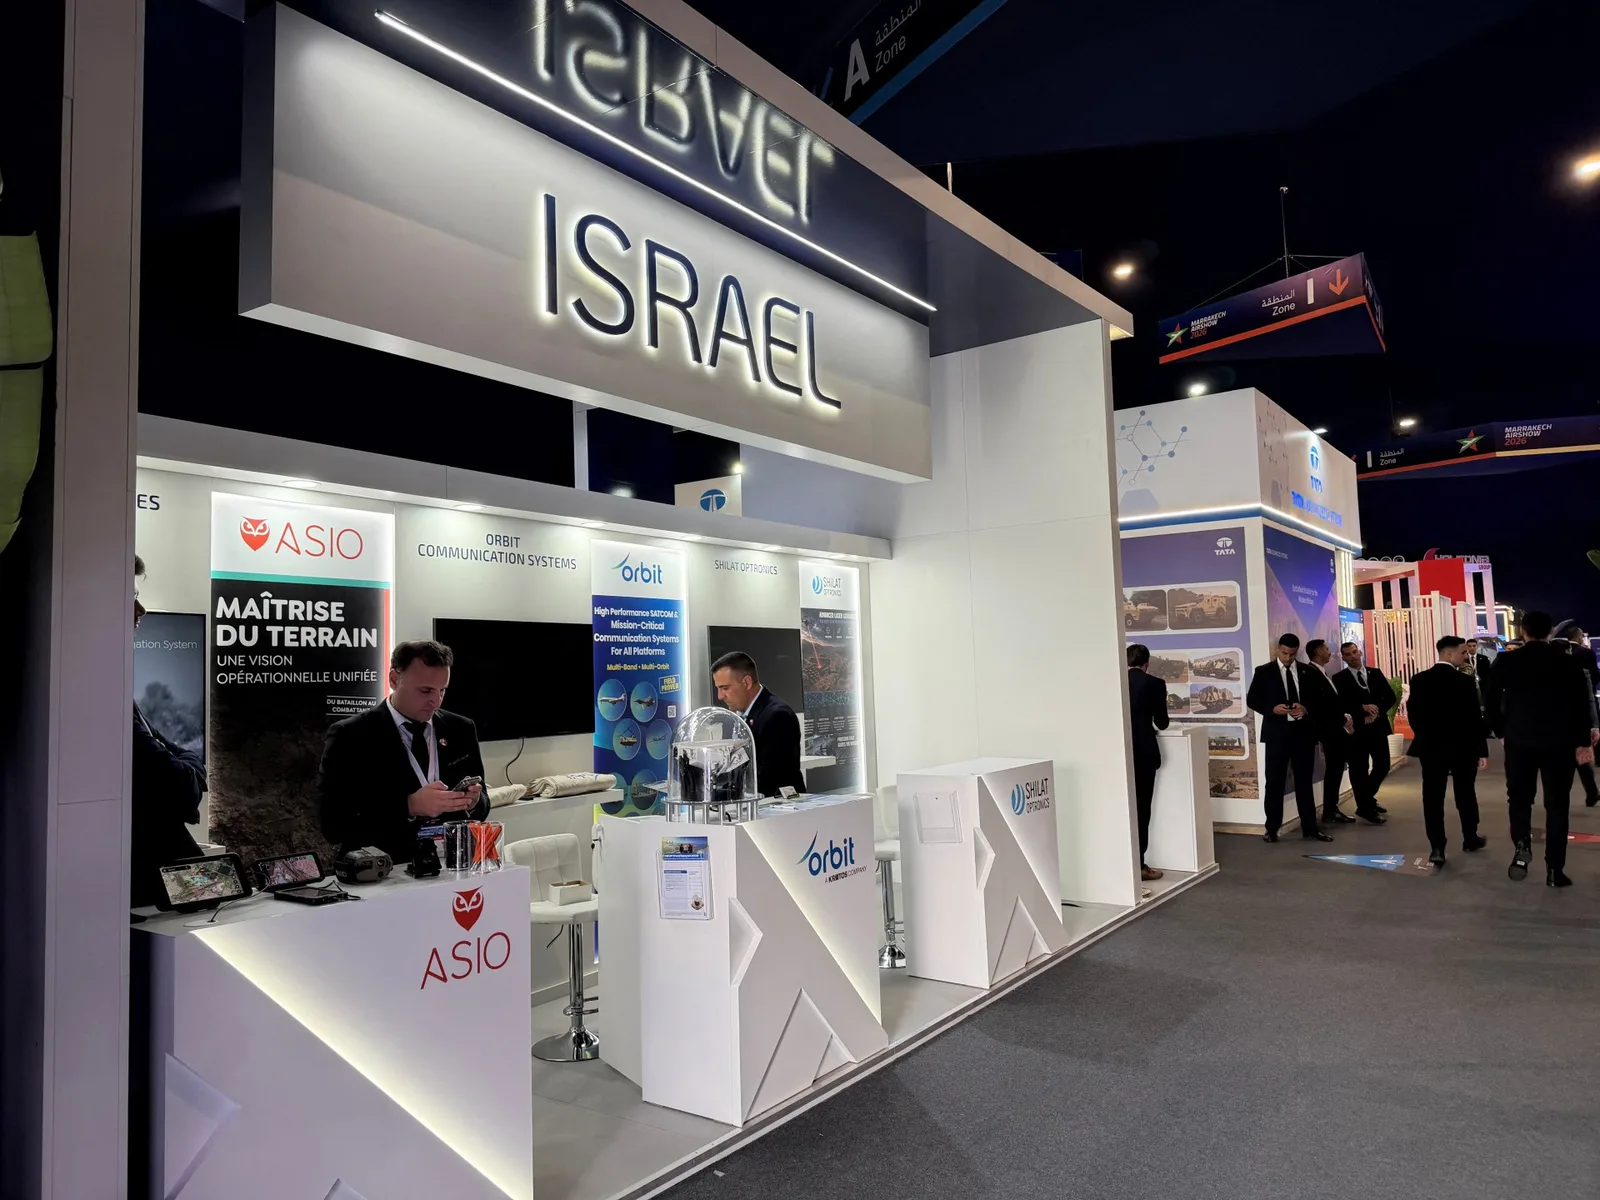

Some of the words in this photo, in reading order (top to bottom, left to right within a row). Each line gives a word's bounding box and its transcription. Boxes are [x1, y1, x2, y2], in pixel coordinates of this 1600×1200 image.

[875, 35, 906, 73] Zone
[844, 38, 871, 102] A
[543, 192, 842, 409] ISRAEL
[1261, 289, 1295, 307] المنطقة
[1272, 302, 1295, 316] Zone
[1190, 311, 1227, 327] MARRAKECH
[1190, 319, 1218, 332] AIRSHOW
[1504, 423, 1552, 433] MARRAKECH
[1504, 430, 1542, 438] AIRSHOW
[1504, 437, 1527, 446] 2026
[1379, 458, 1397, 466] Zone
[137, 493, 160, 511] ES
[275, 522, 363, 560] ASIO
[485, 533, 520, 549] ORBIT
[418, 543, 525, 566] COMMUNICATION
[528, 554, 577, 570] SYSTEMS
[1214, 548, 1236, 556] TATA
[622, 562, 662, 584] orbit
[714, 560, 739, 572] SHILAT
[740, 562, 778, 575] OPTRONICS
[823, 576, 841, 588] SHILAT
[216, 591, 345, 622] MAÎTRISE
[594, 607, 609, 617] High
[610, 608, 649, 617] Performance
[650, 610, 673, 618] SATCOM
[611, 620, 664, 630] Mission-Critical
[216, 625, 259, 647] DU
[266, 625, 377, 648] TERRAIN
[594, 633, 651, 643] Communication
[652, 634, 680, 645] Systems
[134, 639, 160, 649] ation
[163, 640, 197, 650] System
[611, 647, 622, 656] For
[623, 647, 632, 656] All
[633, 647, 665, 656] Platforms
[217, 655, 246, 667] UNE
[249, 655, 293, 667] VISION
[217, 670, 330, 684] OPÉRATIONNELLE
[333, 669, 378, 683] UNIFIÉE
[1025, 778, 1049, 799] SHILAT
[1026, 797, 1050, 814] OPTRONICS
[808, 837, 855, 876] orbit
[848, 865, 867, 877] COMPANY
[420, 932, 511, 990] ASIO
